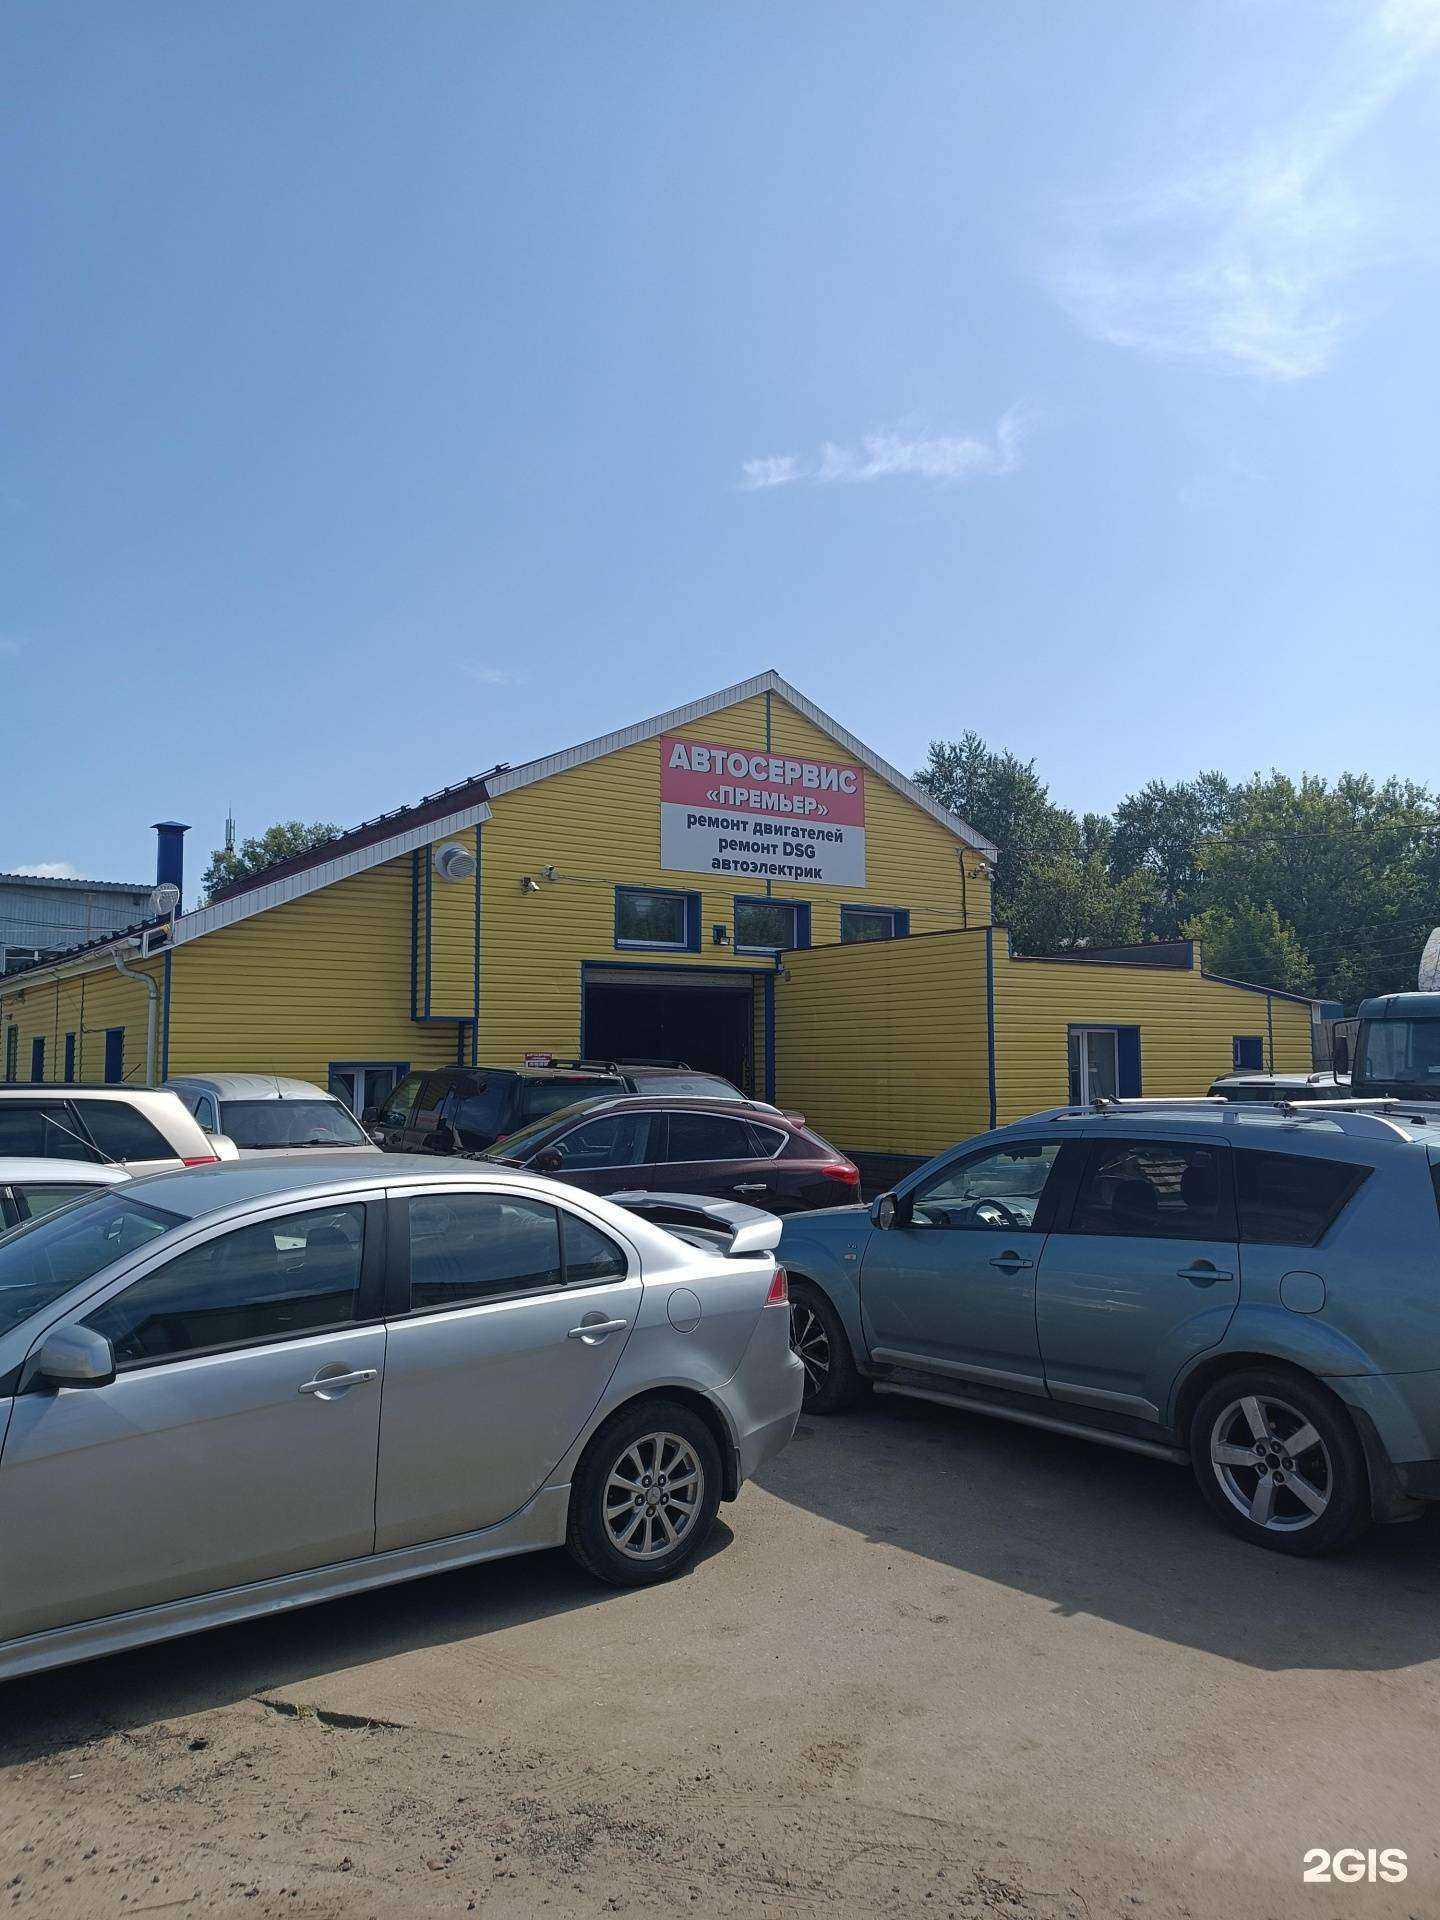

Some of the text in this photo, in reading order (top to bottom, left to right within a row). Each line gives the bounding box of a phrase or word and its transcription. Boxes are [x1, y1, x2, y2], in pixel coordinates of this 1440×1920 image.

[669, 743, 857, 795] АВТОСЕРВИС
[706, 785, 829, 816] «ПРЕМЬЕР»
[687, 813, 844, 843] ремонт двигателей
[718, 838, 816, 859] ремонт DSG
[711, 857, 823, 880] автоэлектрик
